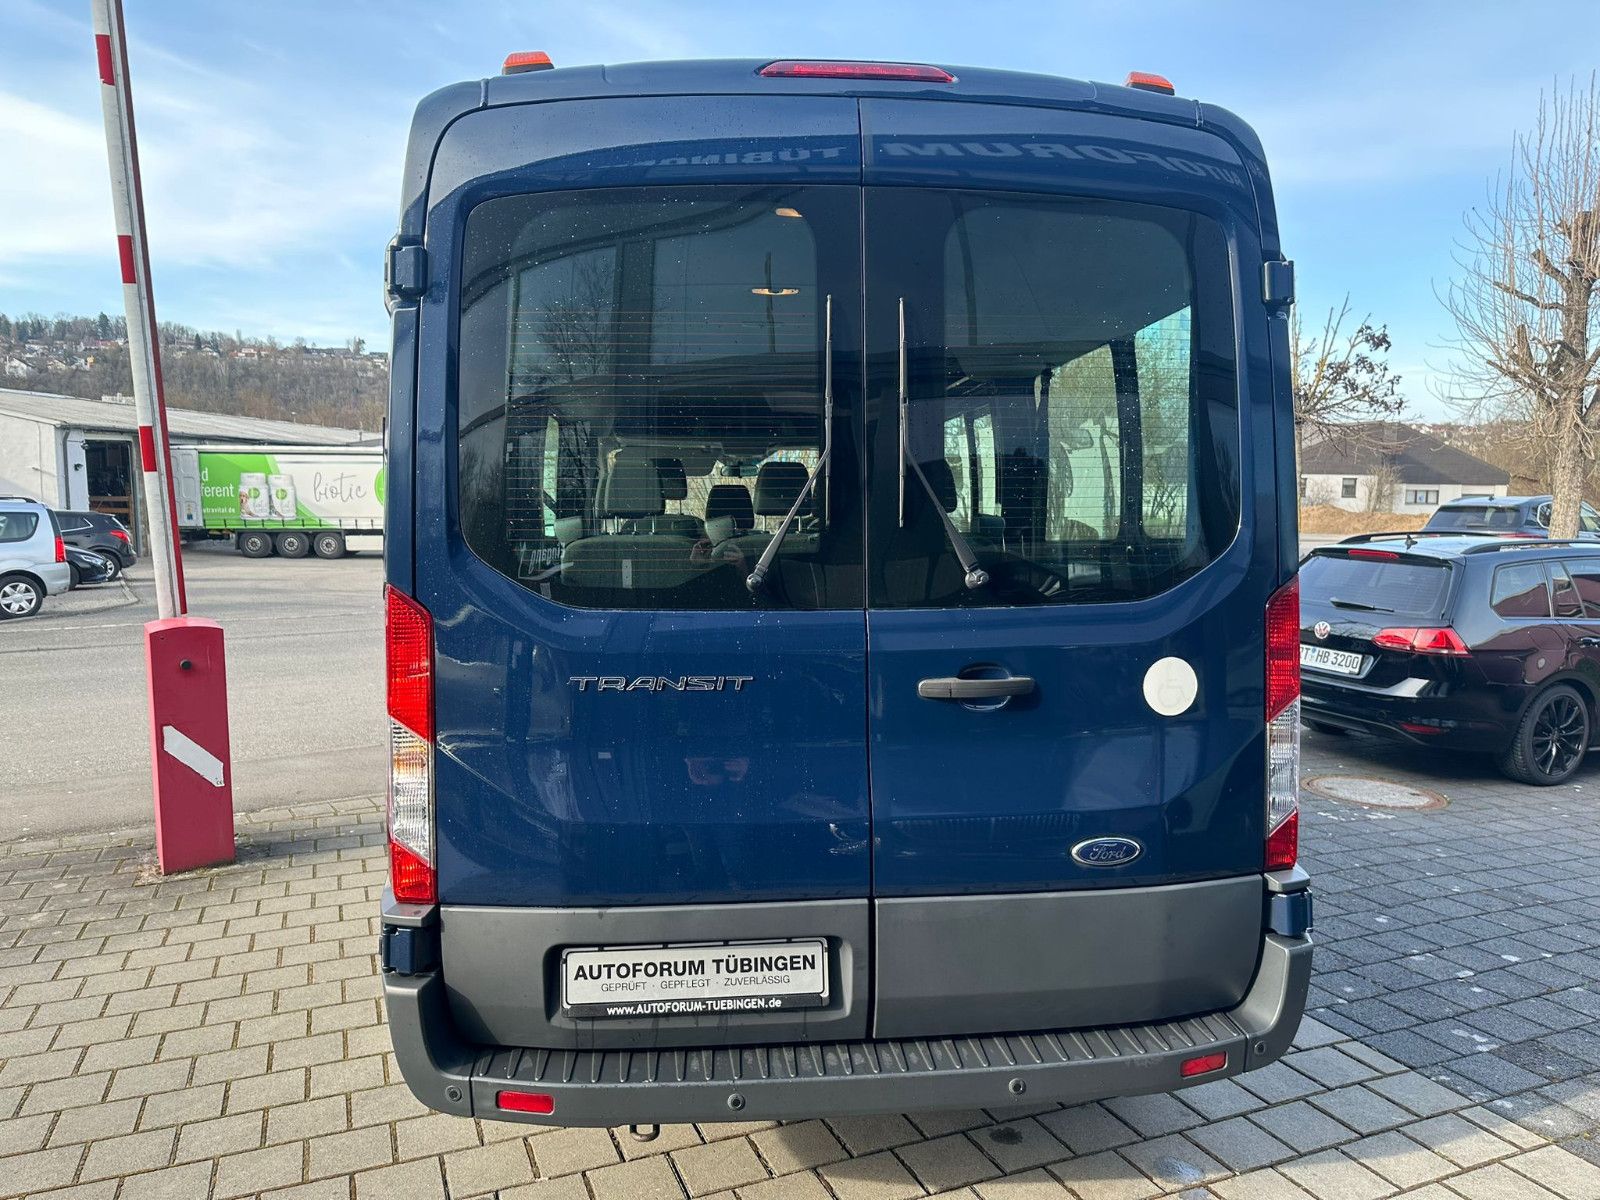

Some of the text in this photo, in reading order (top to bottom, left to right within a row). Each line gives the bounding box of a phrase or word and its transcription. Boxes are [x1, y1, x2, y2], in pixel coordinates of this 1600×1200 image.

[313, 471, 367, 503] biotic
[1315, 649, 1330, 664] HB
[1331, 652, 1360, 670] 3200
[569, 676, 754, 691] TRANSIT
[1089, 843, 1127, 860] Ford
[574, 953, 816, 981] AUTOFORUM TÜBINGEN
[601, 974, 791, 992] GEPRÜFT GEPFLEGT ZUVERLÄSSIG
[606, 997, 782, 1016] www.AUTOFORUM-TUEBINGEN.de
